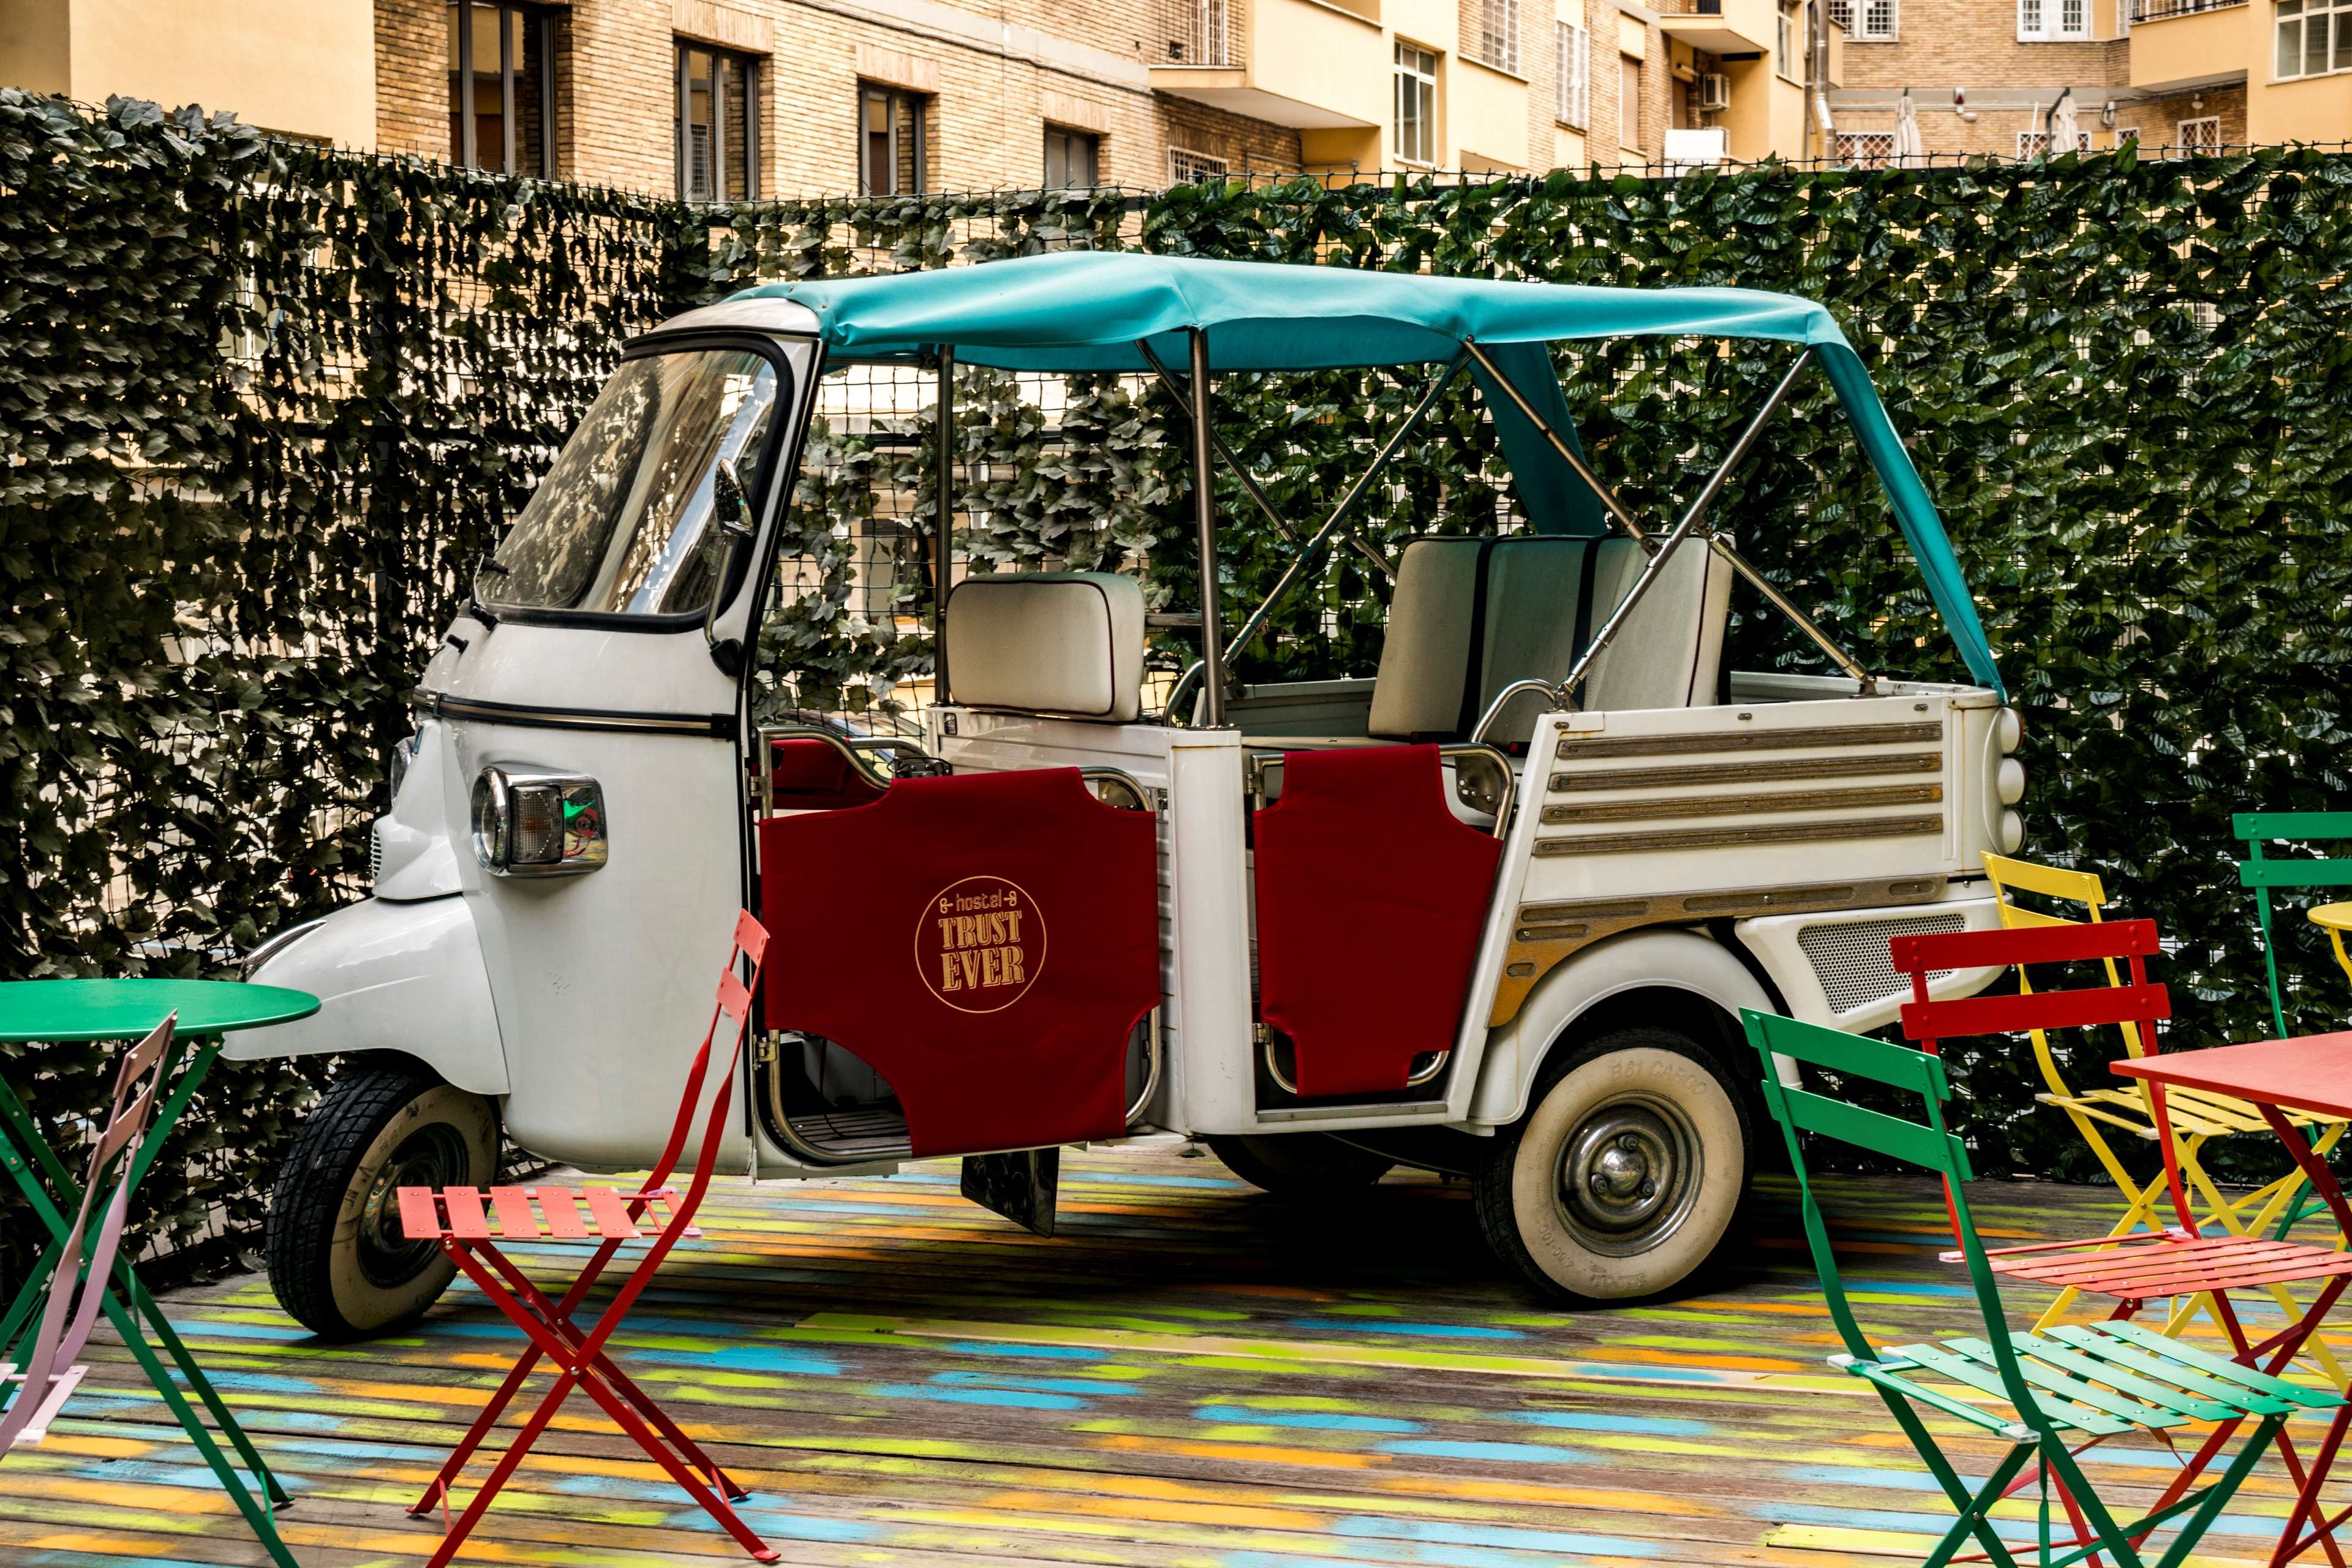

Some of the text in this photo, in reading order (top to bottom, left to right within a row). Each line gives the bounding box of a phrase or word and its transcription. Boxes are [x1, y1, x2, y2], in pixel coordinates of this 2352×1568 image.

[956, 889, 1002, 911] hostel
[938, 910, 1023, 949] TRUST
[940, 946, 1025, 992] EVER
